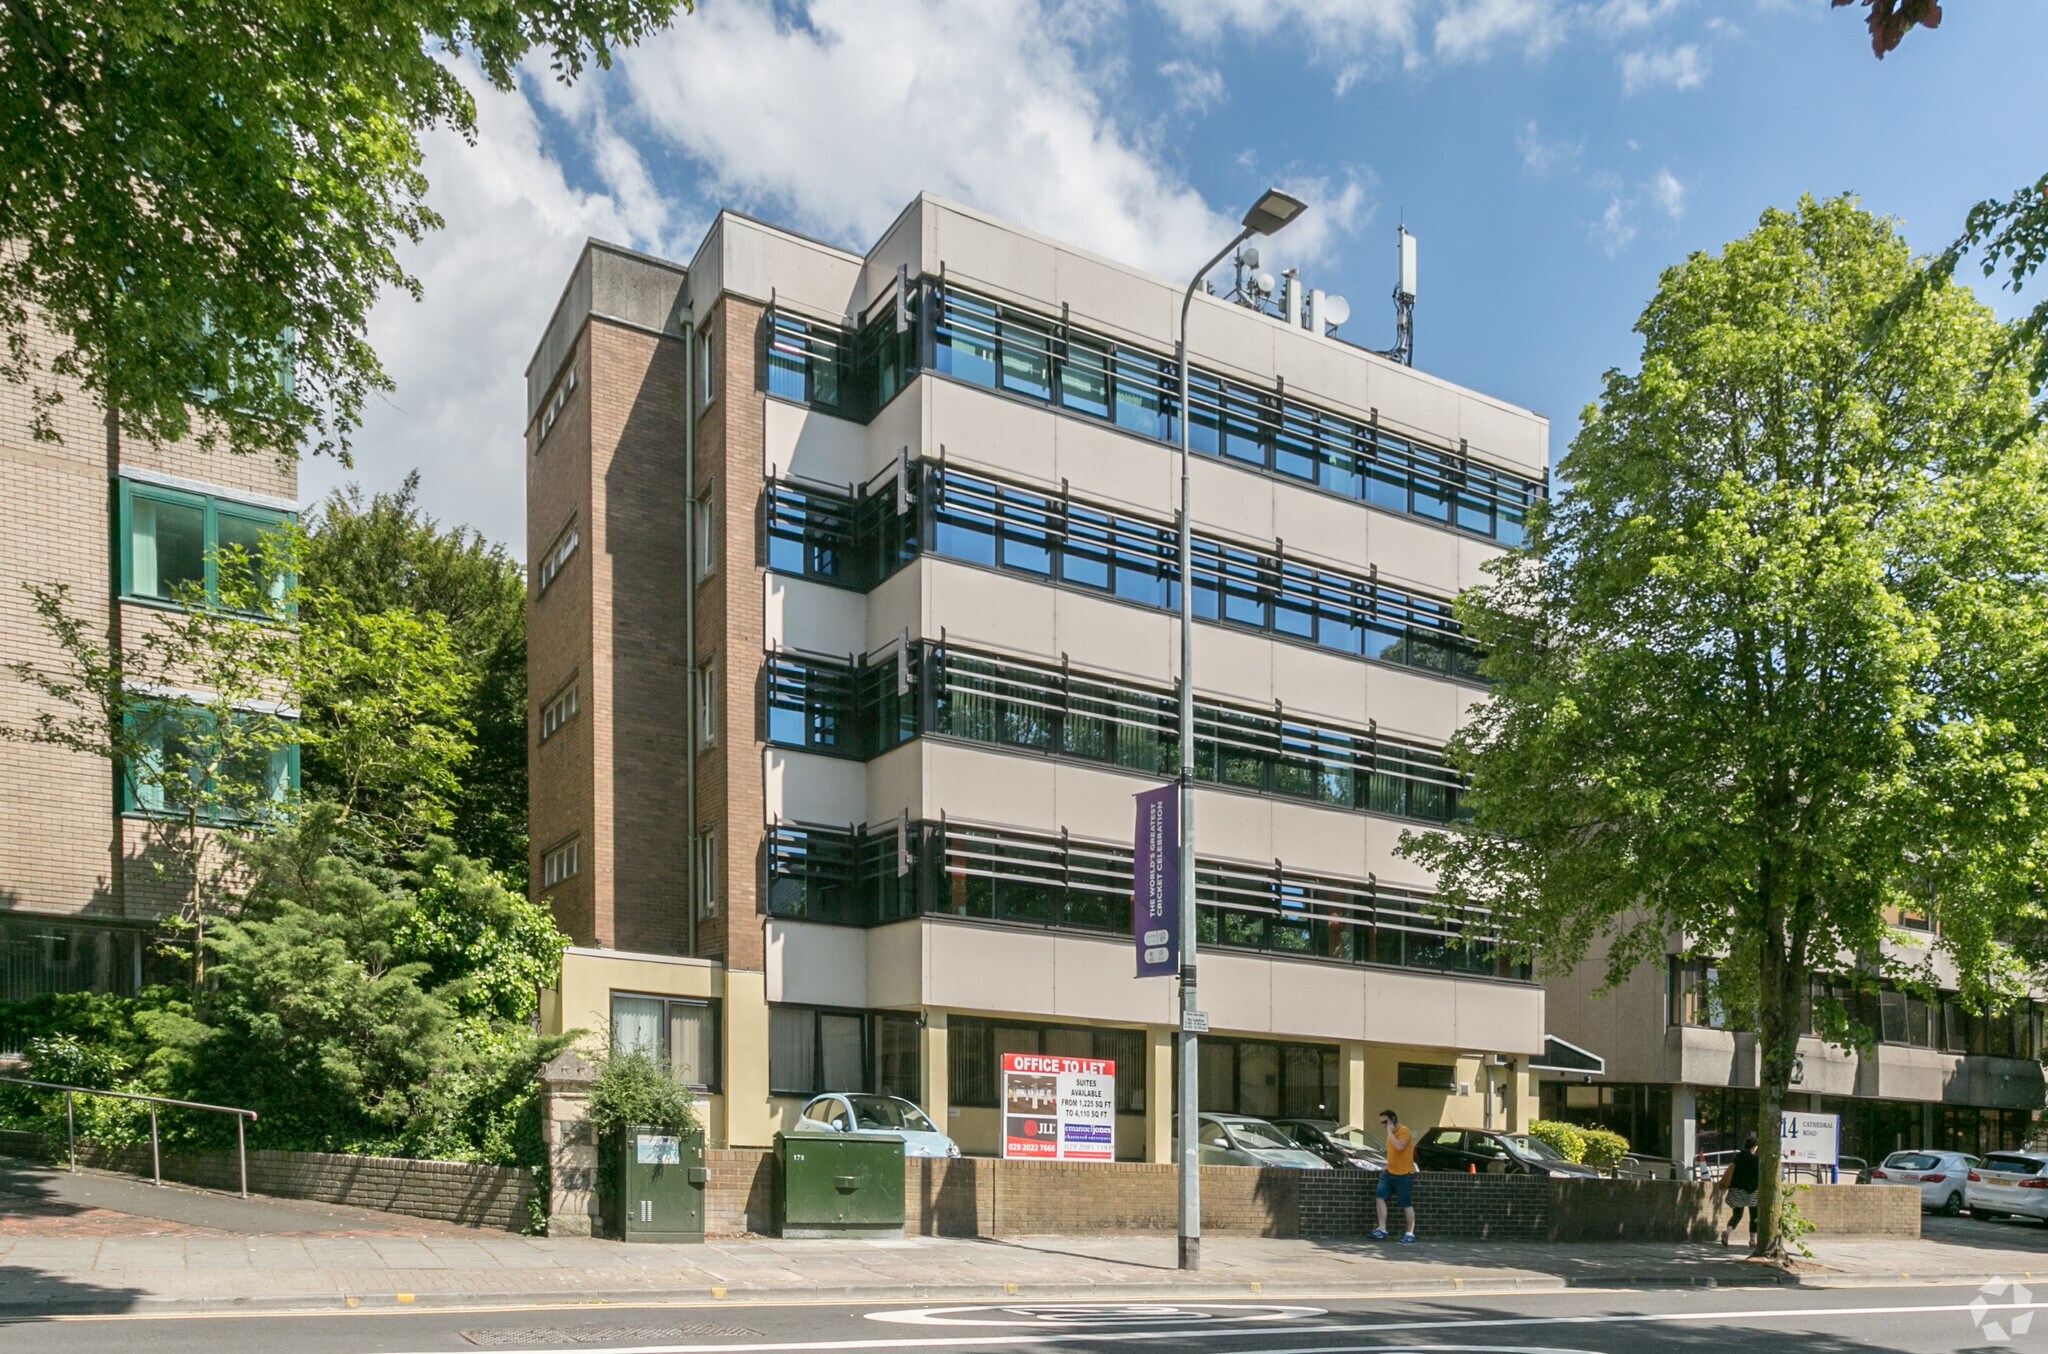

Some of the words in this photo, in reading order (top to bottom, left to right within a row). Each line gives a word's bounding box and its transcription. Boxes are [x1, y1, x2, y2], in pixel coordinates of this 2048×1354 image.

[1014, 1056, 1060, 1073] OFFICE
[1062, 1060, 1079, 1074] TO
[1082, 1061, 1106, 1075] LET
[1076, 1079, 1097, 1087] SUITES
[1071, 1089, 1102, 1098] AVAILABLE
[1061, 1099, 1078, 1107] FROM
[1079, 1100, 1094, 1108] 1,225
[1066, 1109, 1073, 1117] TO
[1075, 1110, 1090, 1118] 4,110
[1037, 1123, 1056, 1134] JLL
[1802, 1121, 1834, 1129] CATHEDRAL
[1008, 1143, 1021, 1151] 029
[1022, 1144, 1039, 1152] 2022
[1039, 1144, 1056, 1152] 7666
